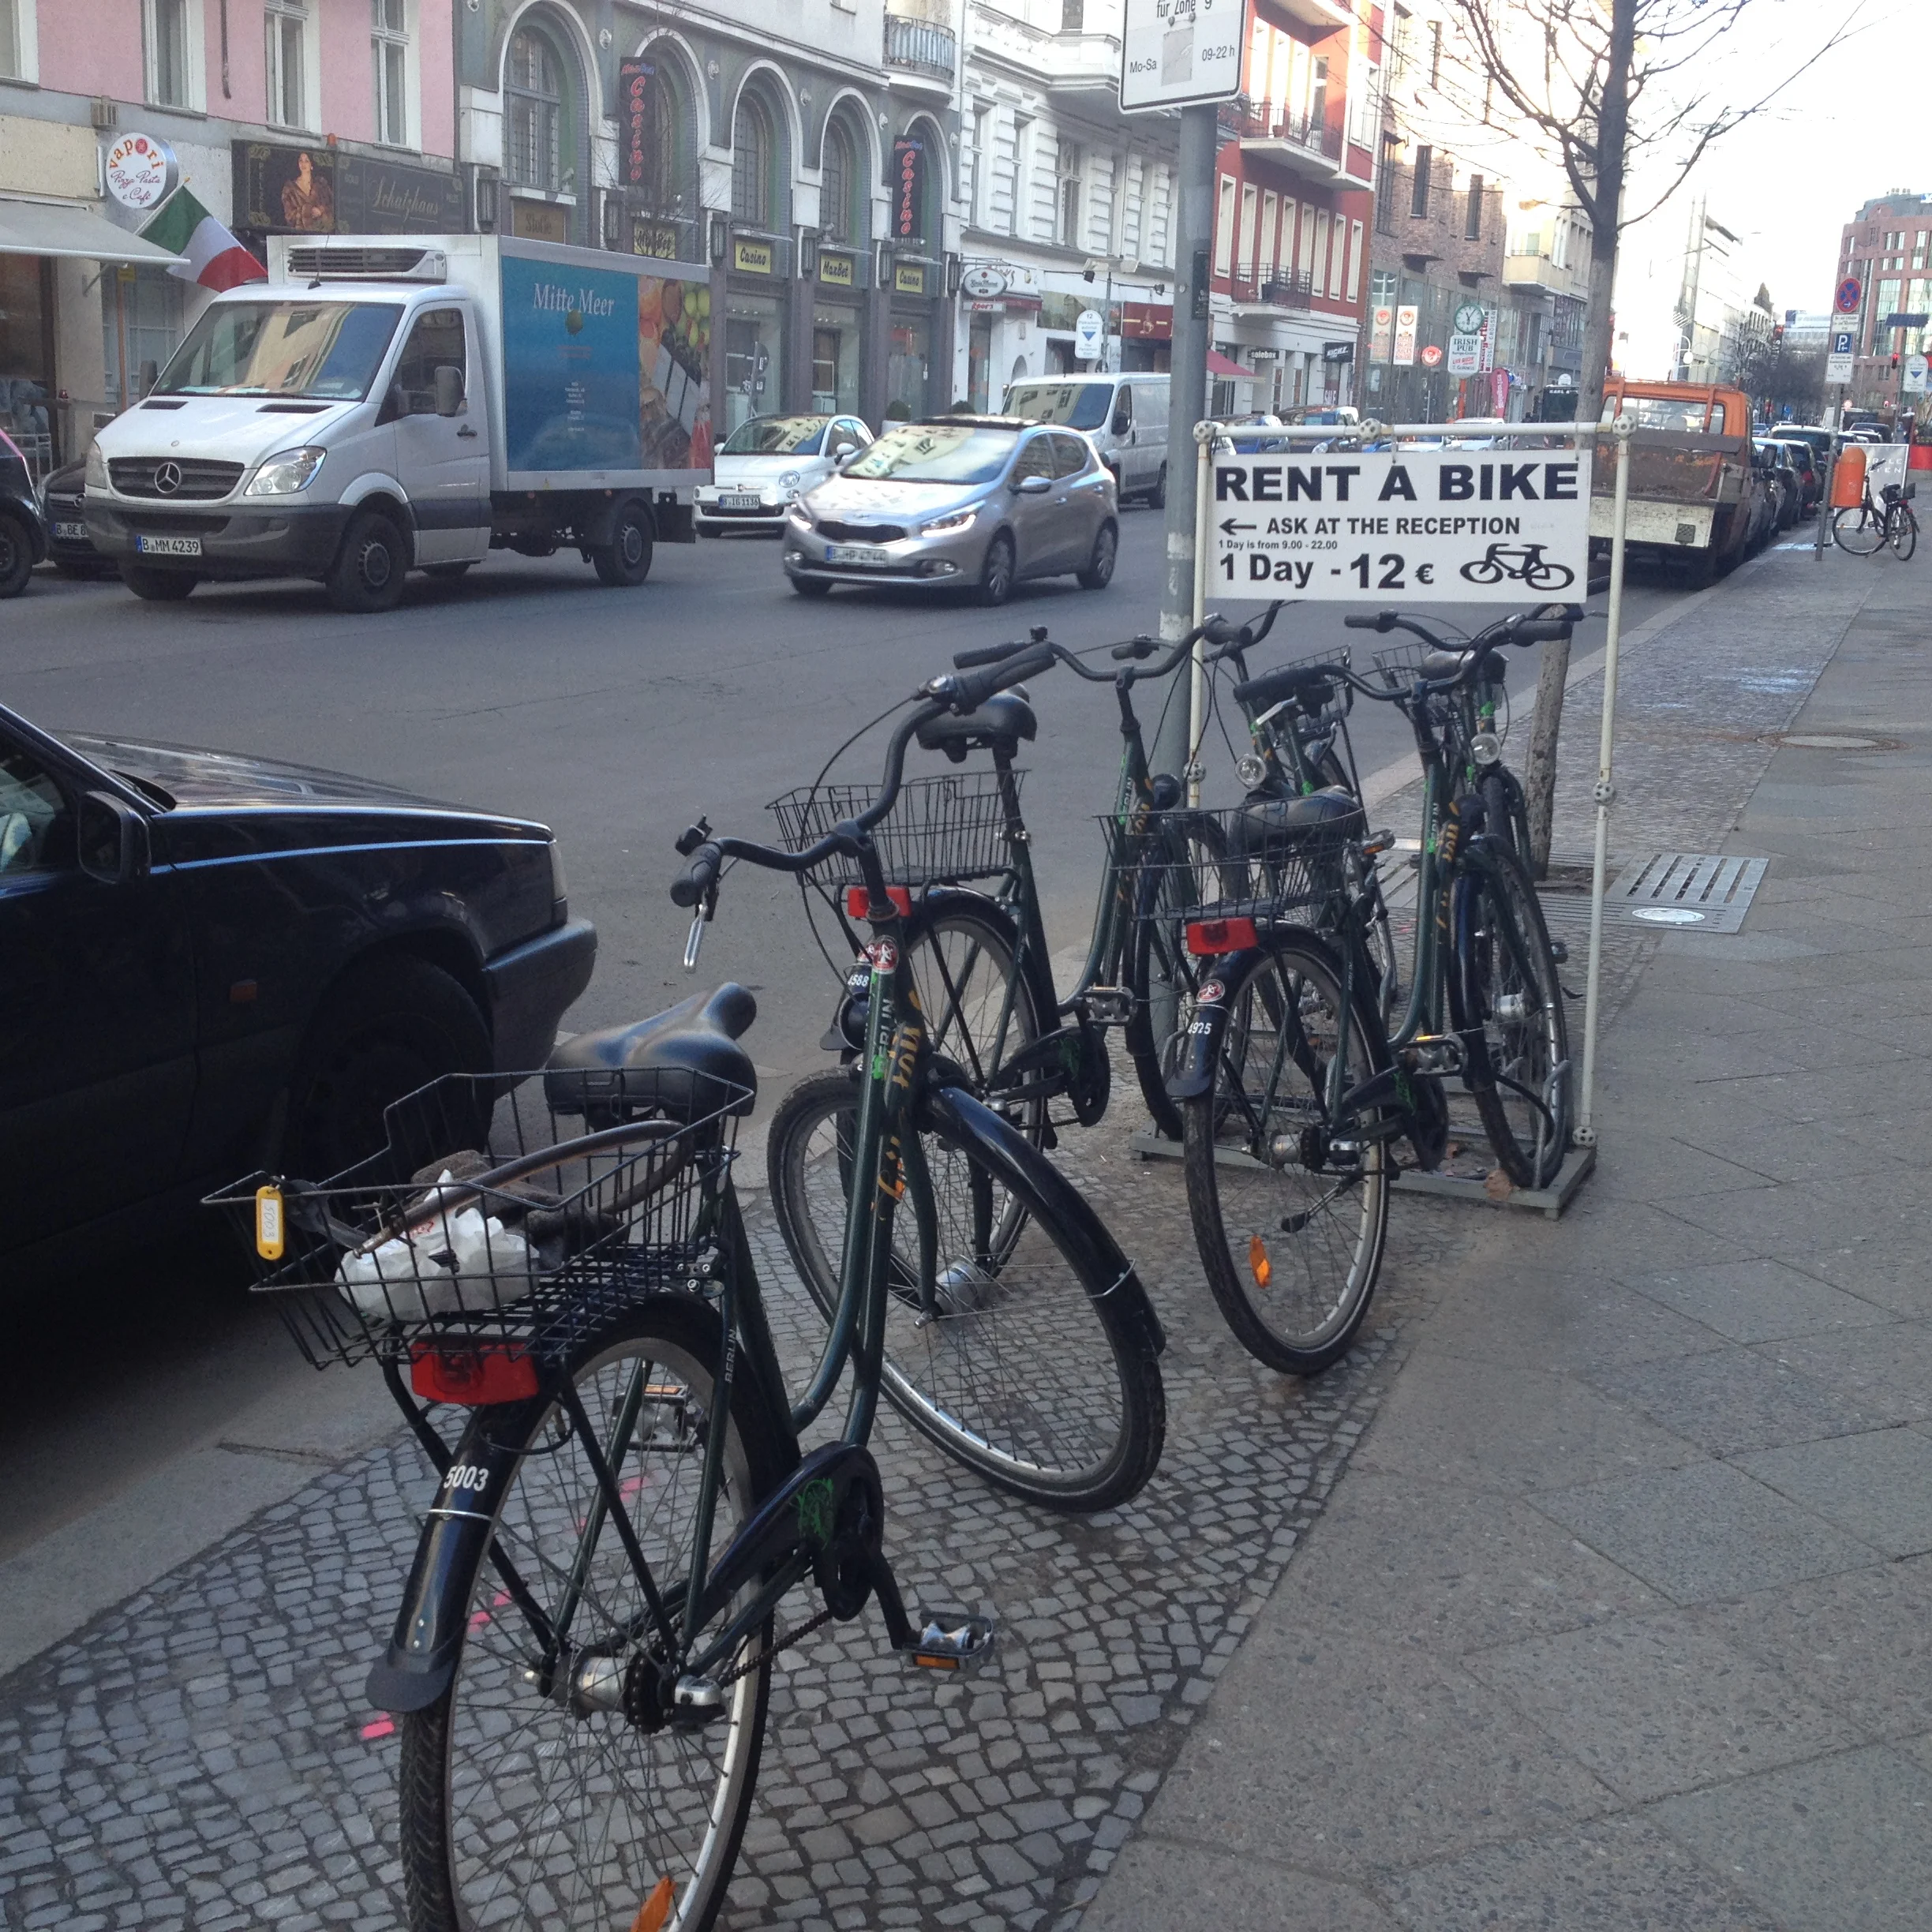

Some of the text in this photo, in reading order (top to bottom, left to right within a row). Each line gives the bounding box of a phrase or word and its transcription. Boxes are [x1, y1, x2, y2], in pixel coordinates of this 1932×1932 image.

[1174, 0, 1196, 15] Zone
[1129, 58, 1157, 73] Mo-Sa
[1202, 46, 1227, 61] 09-22
[629, 76, 646, 181] Casino
[110, 170, 161, 189] Pizza Pasta
[372, 175, 440, 222] Schatzhaus
[900, 151, 915, 234] Casino
[739, 246, 766, 266] Casino
[822, 261, 849, 278] MaxBet
[899, 271, 919, 287] Casino
[534, 283, 616, 316] Mitte Meer
[1837, 335, 1848, 351] P
[1215, 462, 1578, 502] RENT A BIKE
[1267, 517, 1520, 534] ASK AT THE RECEPTION
[155, 540, 170, 552] MM
[172, 541, 199, 553] 4239
[1219, 540, 1223, 549] 1
[1226, 540, 1245, 550] Day
[1247, 540, 1255, 549] is
[1257, 540, 1279, 549] from
[1282, 540, 1302, 549] 9.00
[1311, 541, 1338, 550] 22.00
[1220, 554, 1234, 580] 1
[1250, 554, 1314, 590] Day
[1415, 564, 1434, 585] €
[1187, 1022, 1212, 1035] 4925
[724, 1327, 738, 1383] BERLIN
[443, 1465, 489, 1492] 5003
